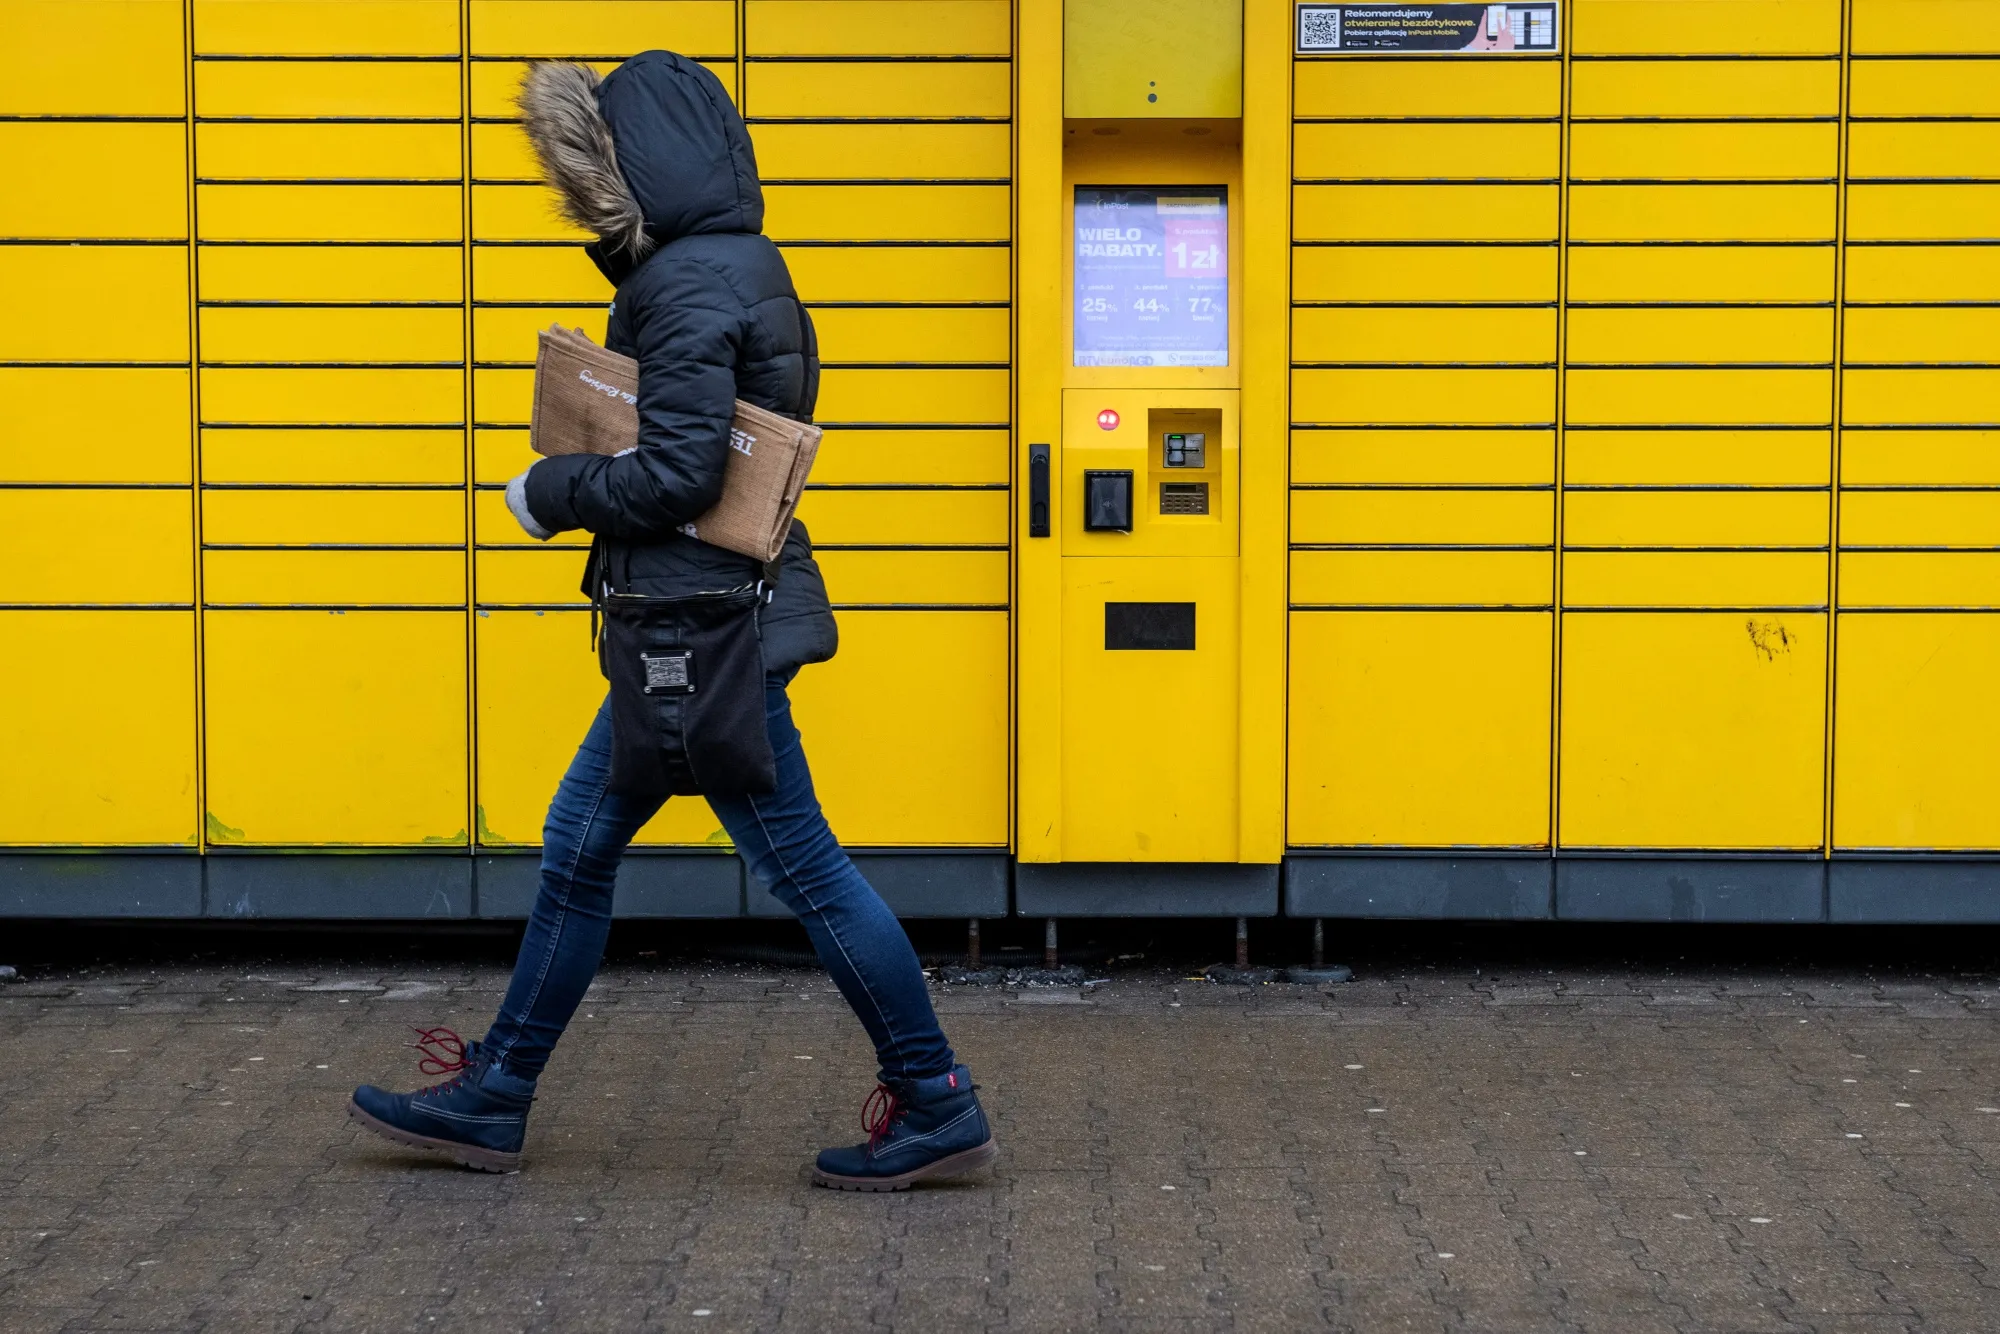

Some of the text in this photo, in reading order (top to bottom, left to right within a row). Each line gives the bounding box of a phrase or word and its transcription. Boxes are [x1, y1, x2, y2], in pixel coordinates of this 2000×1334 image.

[1344, 9, 1433, 19] Rekomendujemy
[1402, 19, 1476, 28] bezdotykowe.
[1374, 29, 1407, 37] aplikację
[1103, 202, 1129, 210] InPost
[1078, 228, 1141, 241] WIELO
[1078, 243, 1162, 257] RABATY.
[1082, 298, 1118, 313] 25%
[1133, 298, 1170, 313] 44%
[1188, 298, 1222, 313] 77%
